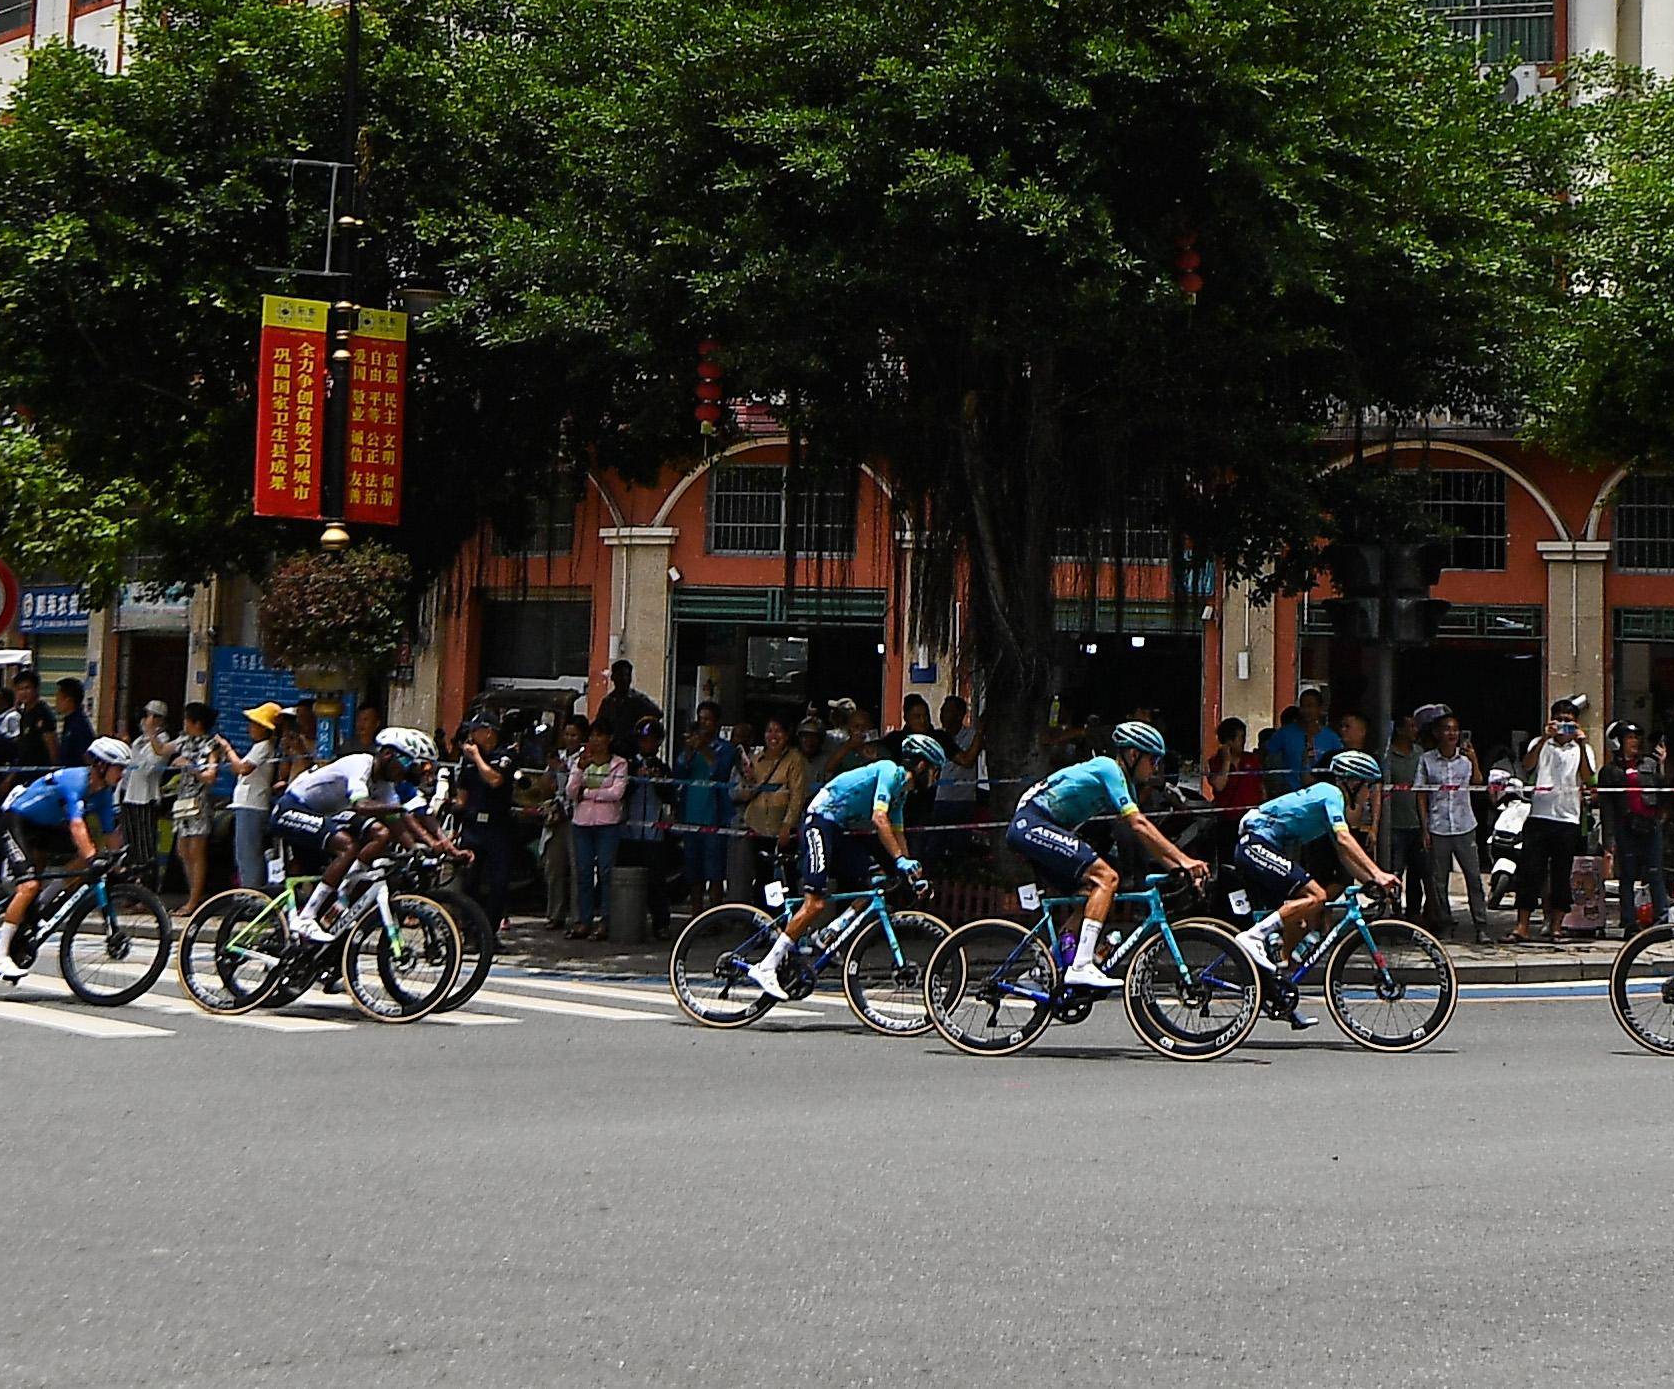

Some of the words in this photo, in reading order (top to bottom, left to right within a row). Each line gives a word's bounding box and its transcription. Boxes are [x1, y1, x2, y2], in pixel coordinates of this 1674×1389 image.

[352, 348, 366, 381] 爱国
[369, 350, 382, 383] 自由
[385, 352, 398, 383] 富强
[269, 348, 292, 491] 巩固国家卫生县成果
[293, 342, 316, 500] 全力争创省级文明城市
[351, 389, 365, 421] 敬业
[368, 391, 381, 423] 平等
[384, 392, 397, 425] 民主
[349, 430, 364, 463] 诚信
[366, 432, 379, 464] 公正
[382, 434, 396, 466] 文明
[348, 471, 362, 504] 友善
[364, 472, 378, 505] 法治
[380, 473, 394, 506] 和谐
[1030, 826, 1079, 852] ASTANA
[1251, 844, 1292, 871] ASTANA
